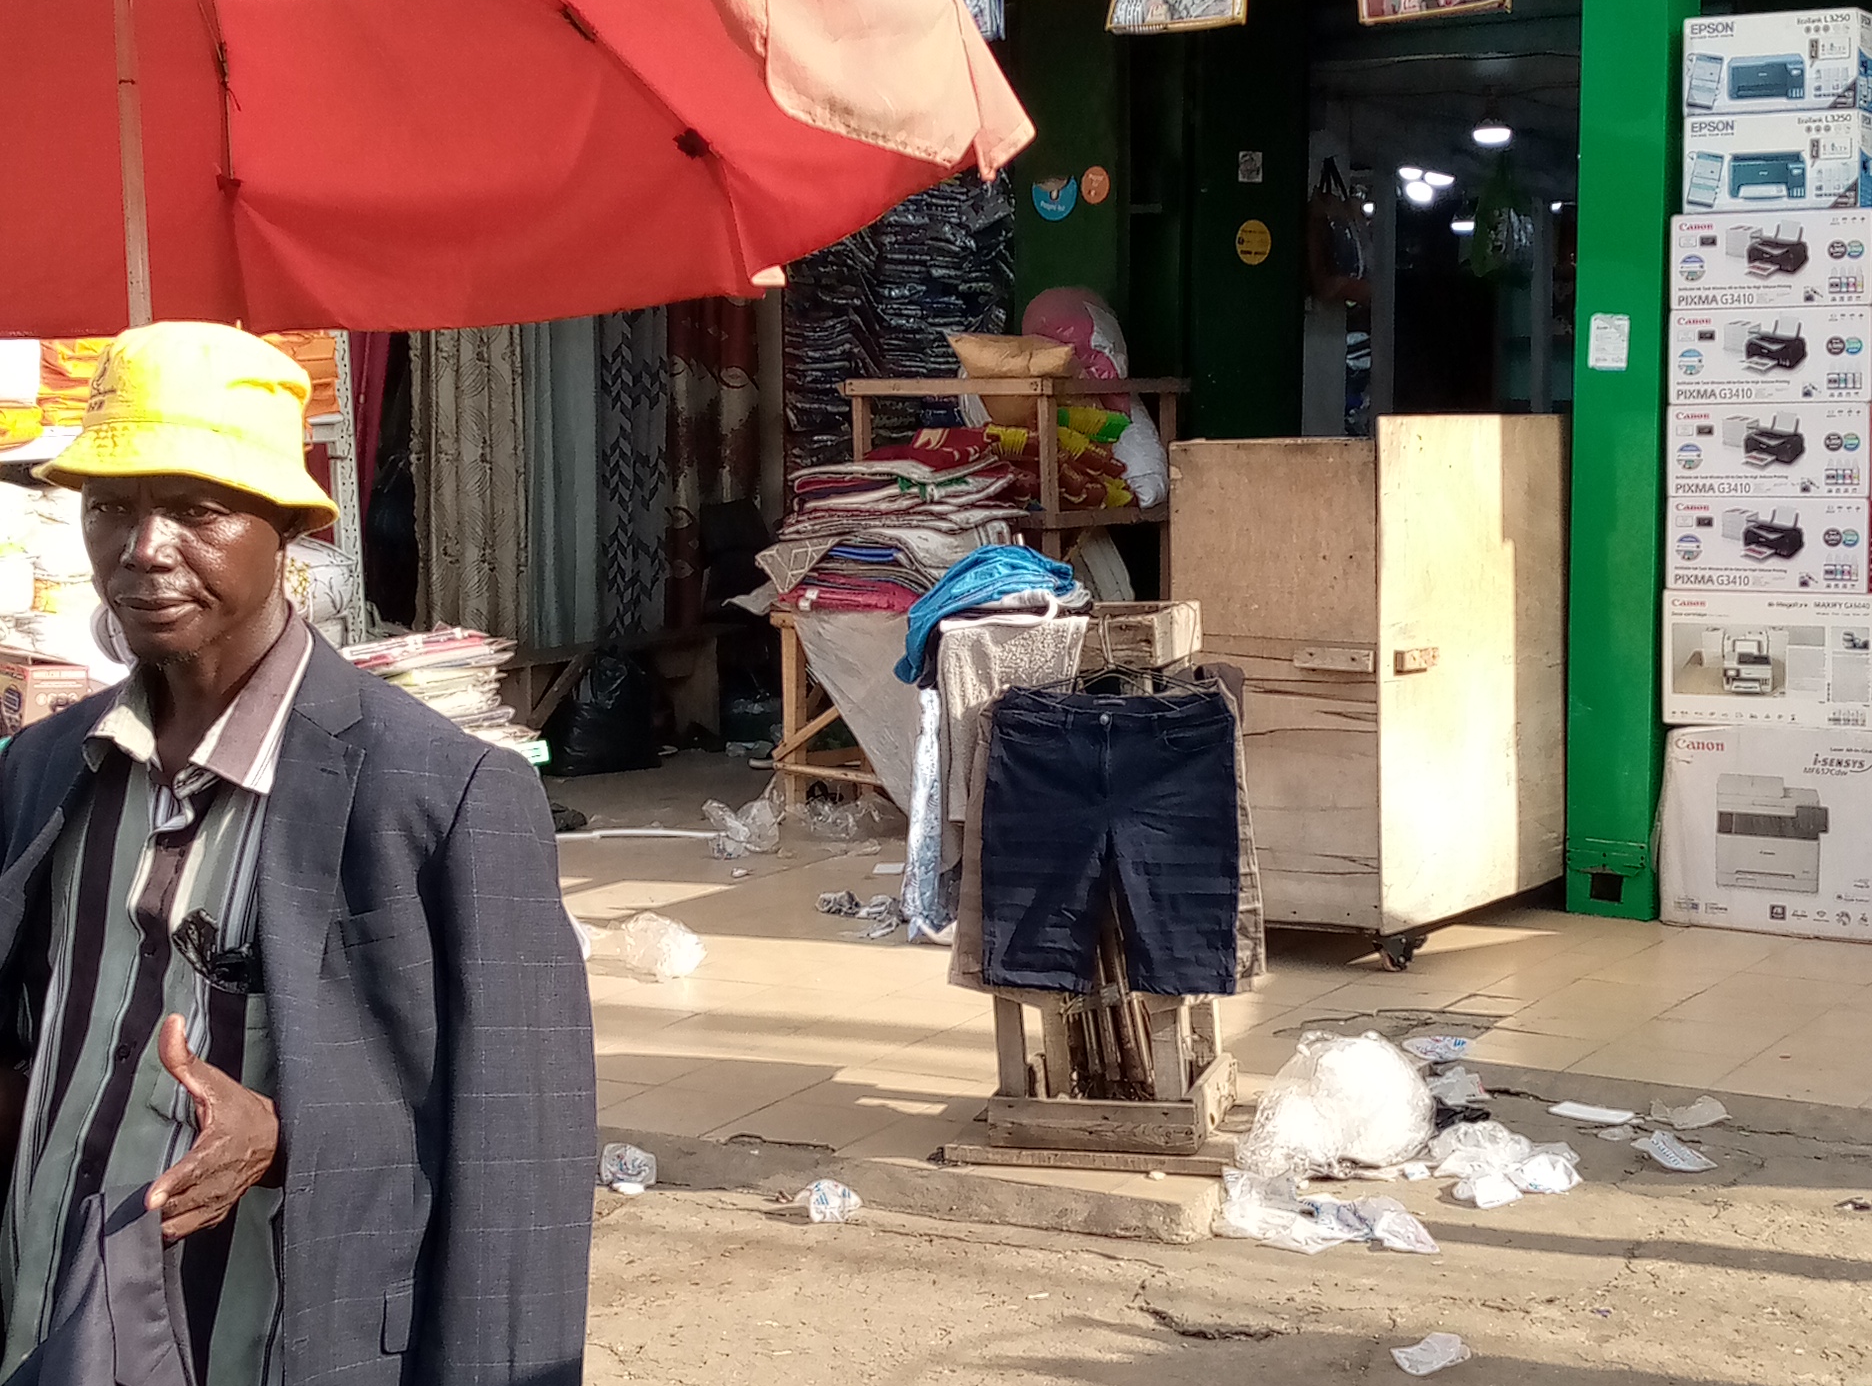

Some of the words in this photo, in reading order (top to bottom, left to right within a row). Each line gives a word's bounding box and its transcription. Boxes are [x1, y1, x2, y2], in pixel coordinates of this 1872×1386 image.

[1823, 13, 1851, 24] L3250
[1690, 21, 1735, 35] EPSON
[1824, 114, 1852, 124] L3250
[1690, 120, 1735, 133] EPSON
[1678, 222, 1714, 231] Canon
[1677, 294, 1718, 306] PIXMA
[1720, 293, 1754, 305] G3410
[1677, 317, 1712, 326] Canon
[1676, 388, 1717, 401] PIXMA
[1718, 388, 1753, 400] G3410
[1675, 412, 1710, 420] Canon
[1675, 483, 1716, 494] PIXMA
[1717, 482, 1751, 494] G3410
[1675, 503, 1710, 511] Canon
[1674, 574, 1715, 586] PIXMA
[1716, 574, 1750, 587] G3410
[1671, 598, 1707, 607] Canon
[1675, 738, 1725, 752] Canon
